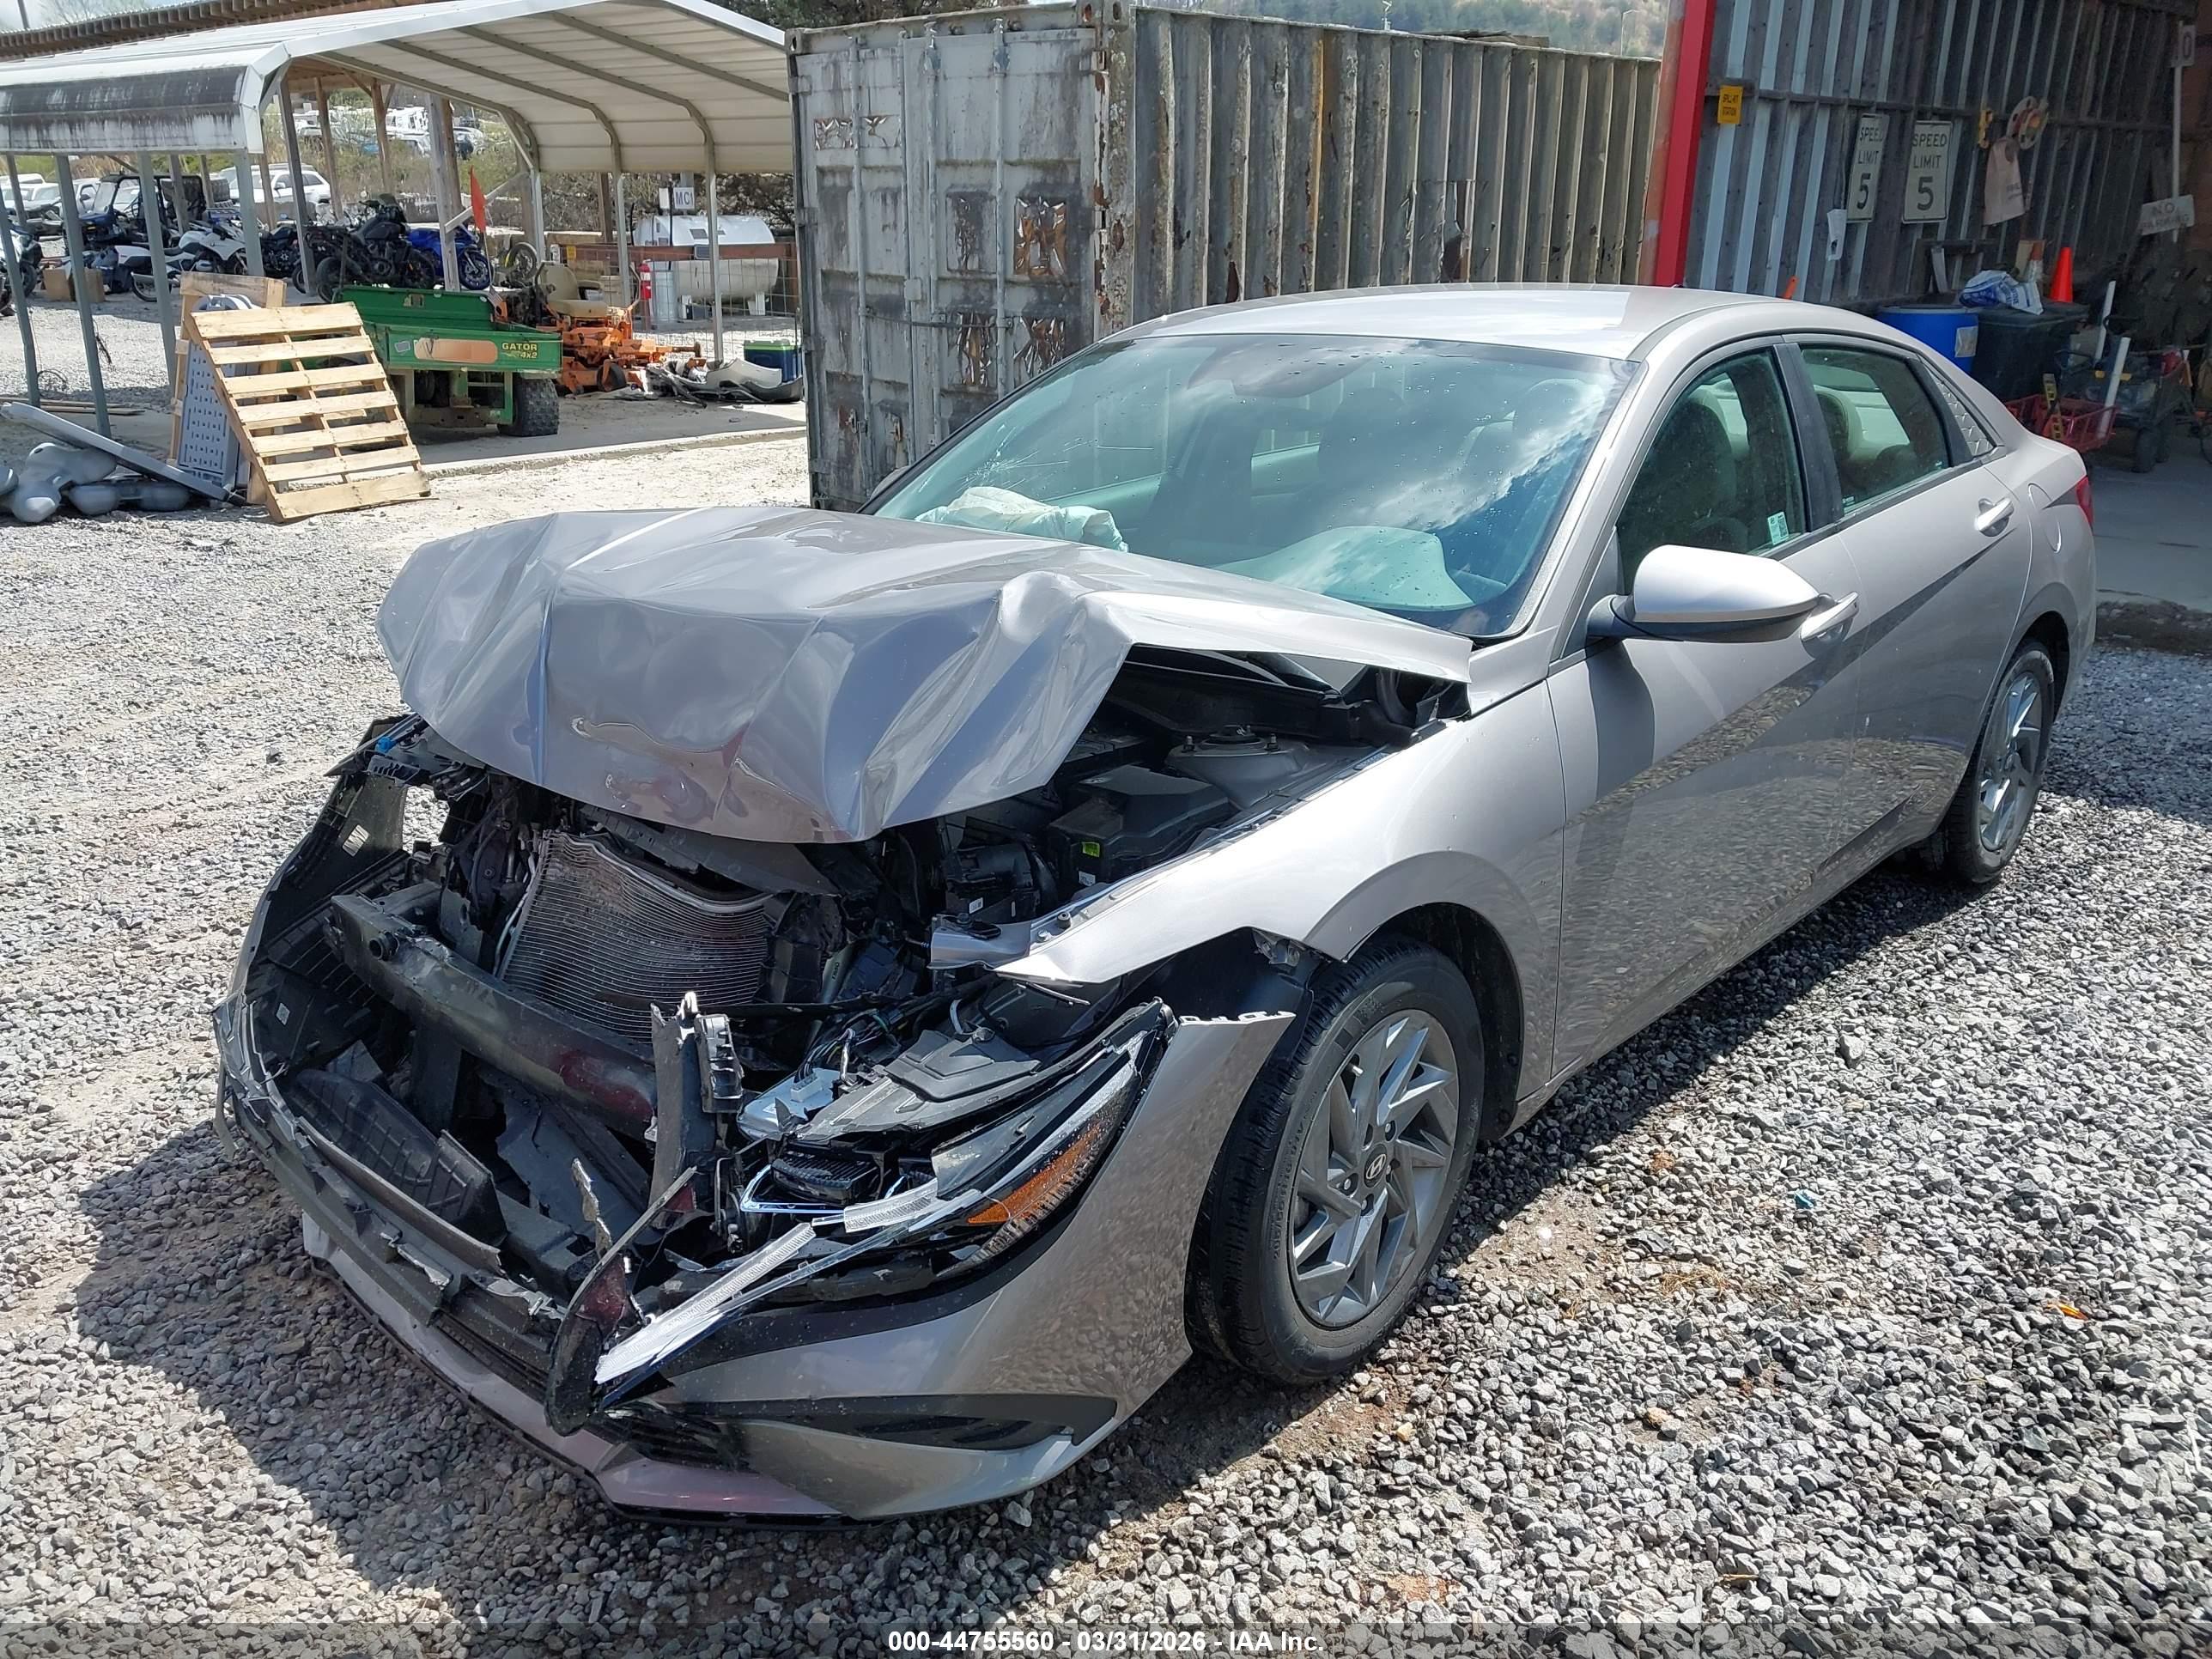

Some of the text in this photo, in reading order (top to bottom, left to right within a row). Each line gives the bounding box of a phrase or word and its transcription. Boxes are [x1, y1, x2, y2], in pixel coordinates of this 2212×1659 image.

[1912, 133, 1948, 147] SPEED
[1857, 150, 1880, 164] LIMIT
[1913, 155, 1942, 168] LIMIT
[1856, 173, 1871, 210] 5
[1917, 176, 1934, 210] 5
[501, 342, 538, 351] GATOR
